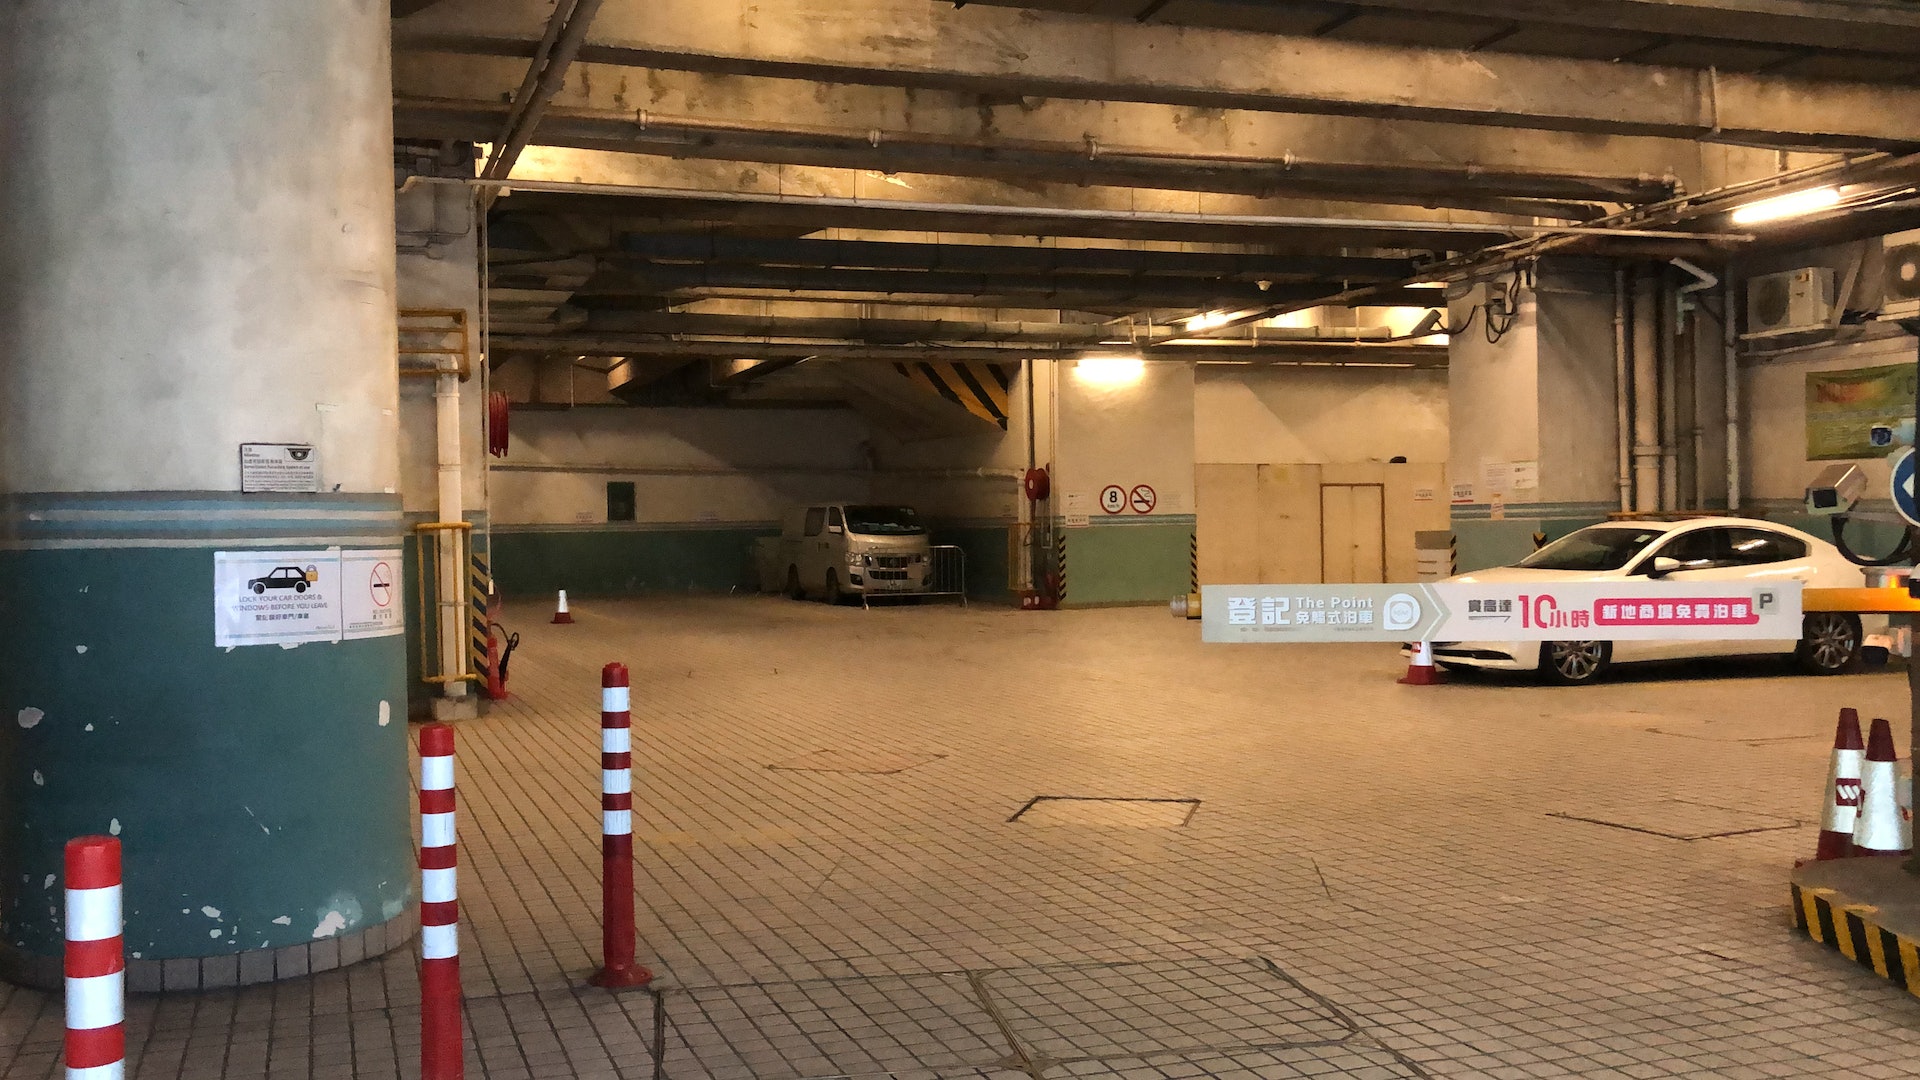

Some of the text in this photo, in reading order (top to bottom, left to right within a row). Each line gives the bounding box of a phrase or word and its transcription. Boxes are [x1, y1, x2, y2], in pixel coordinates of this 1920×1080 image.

[1109, 490, 1117, 503] 8
[239, 595, 257, 603] LOCK
[1296, 597, 1373, 608] The Point
[1759, 593, 1773, 609] P
[1228, 597, 1291, 625] 登記
